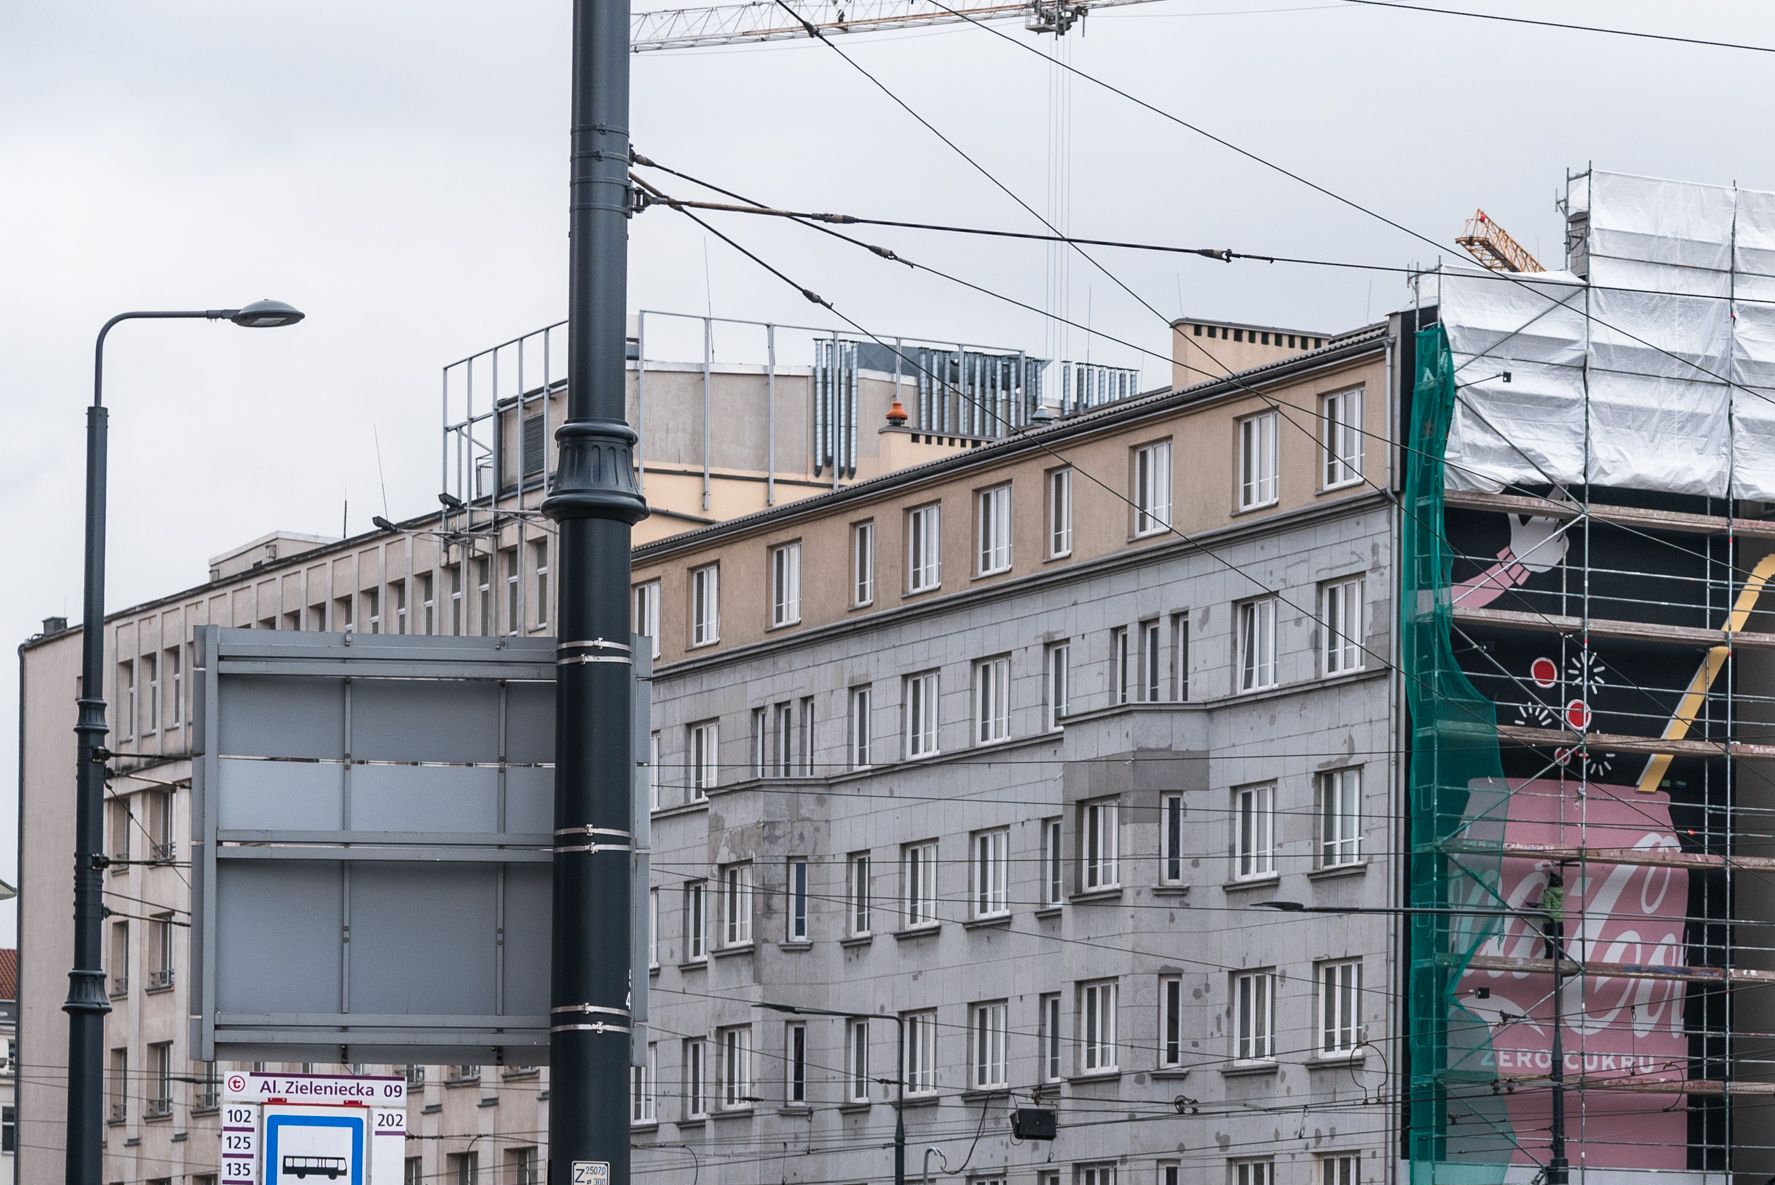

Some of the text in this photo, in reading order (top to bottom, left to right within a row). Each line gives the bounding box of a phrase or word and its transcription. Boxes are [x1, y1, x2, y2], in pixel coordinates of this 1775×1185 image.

[1480, 1049, 1654, 1073] ZERO CUKRU
[260, 1080, 281, 1094] Al.
[285, 1081, 374, 1096] Zieleniecka
[384, 1084, 402, 1098] 09
[227, 1110, 252, 1122] 102
[377, 1114, 404, 1126] 202
[226, 1136, 251, 1150] 125
[226, 1163, 250, 1176] 135
[575, 1168, 585, 1183] Z
